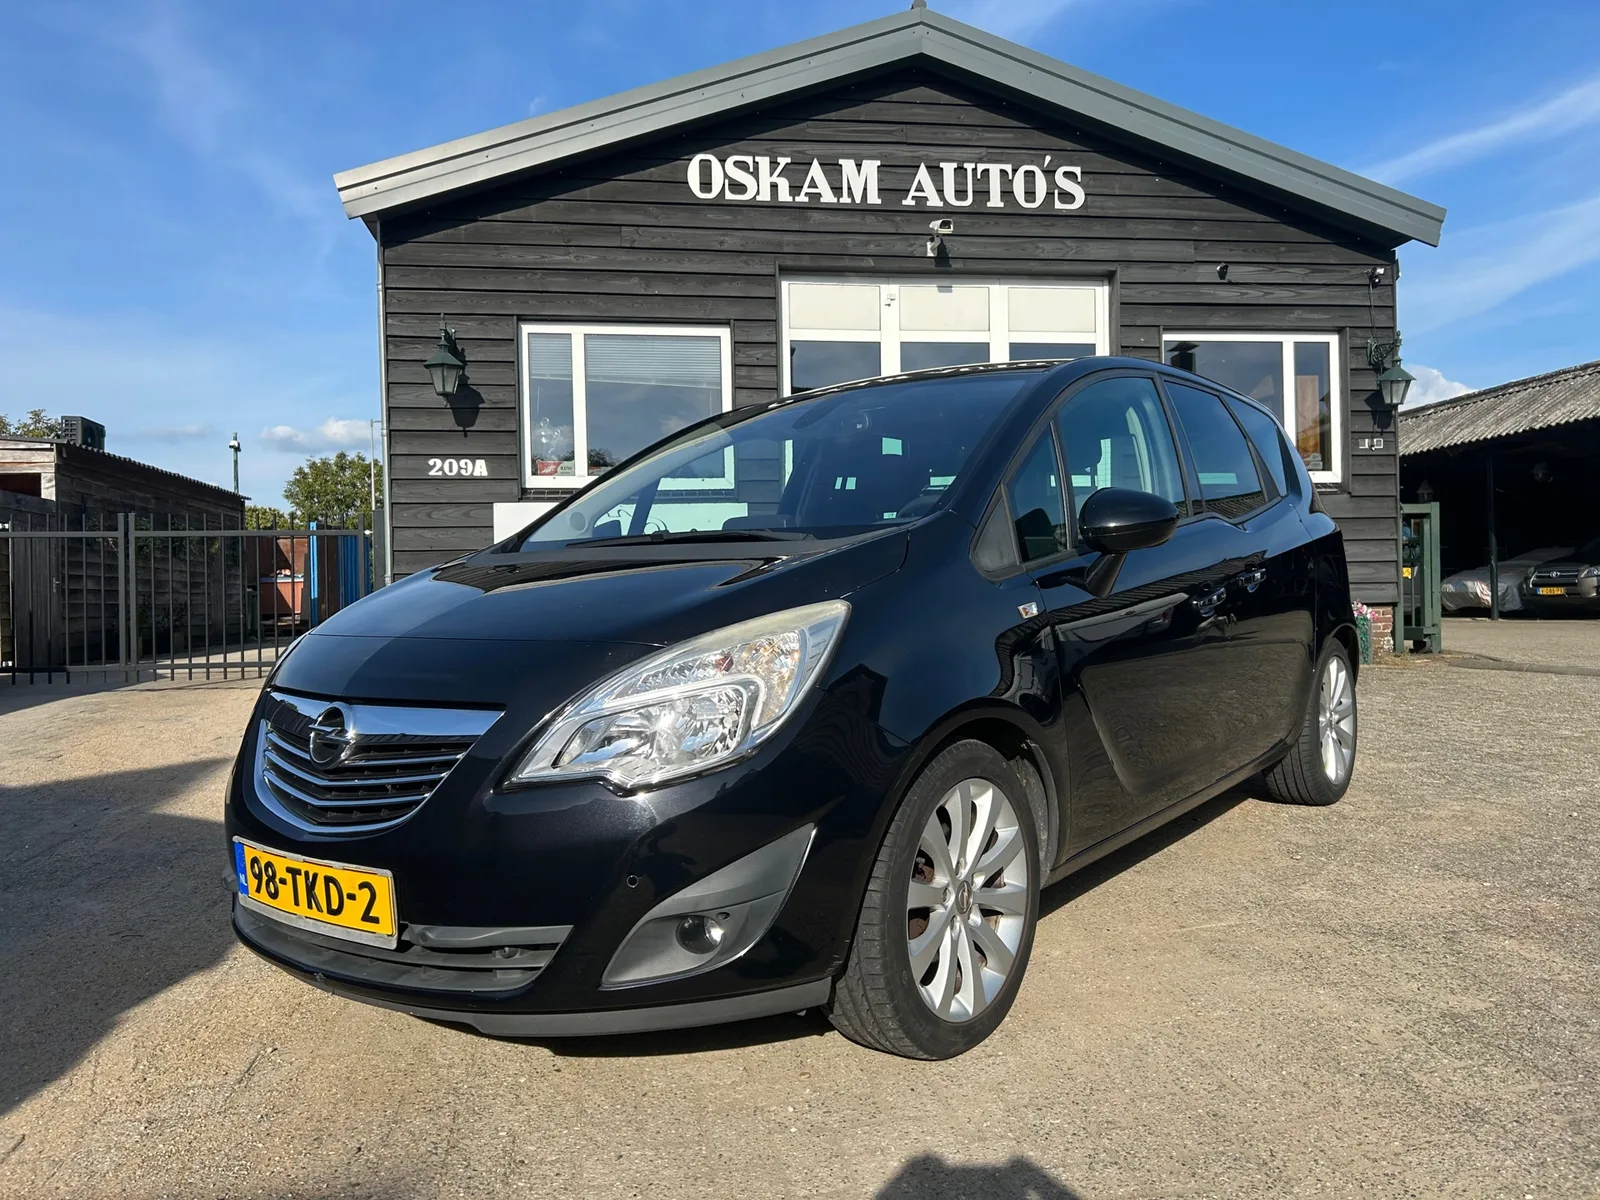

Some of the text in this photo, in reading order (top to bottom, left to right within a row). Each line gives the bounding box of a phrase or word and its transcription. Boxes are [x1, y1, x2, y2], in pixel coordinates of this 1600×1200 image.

[687, 153, 1086, 210] OSKAM AUTO'S
[428, 458, 488, 477] 209A
[239, 872, 248, 886] NL
[249, 855, 381, 924] 98-TKD-2
